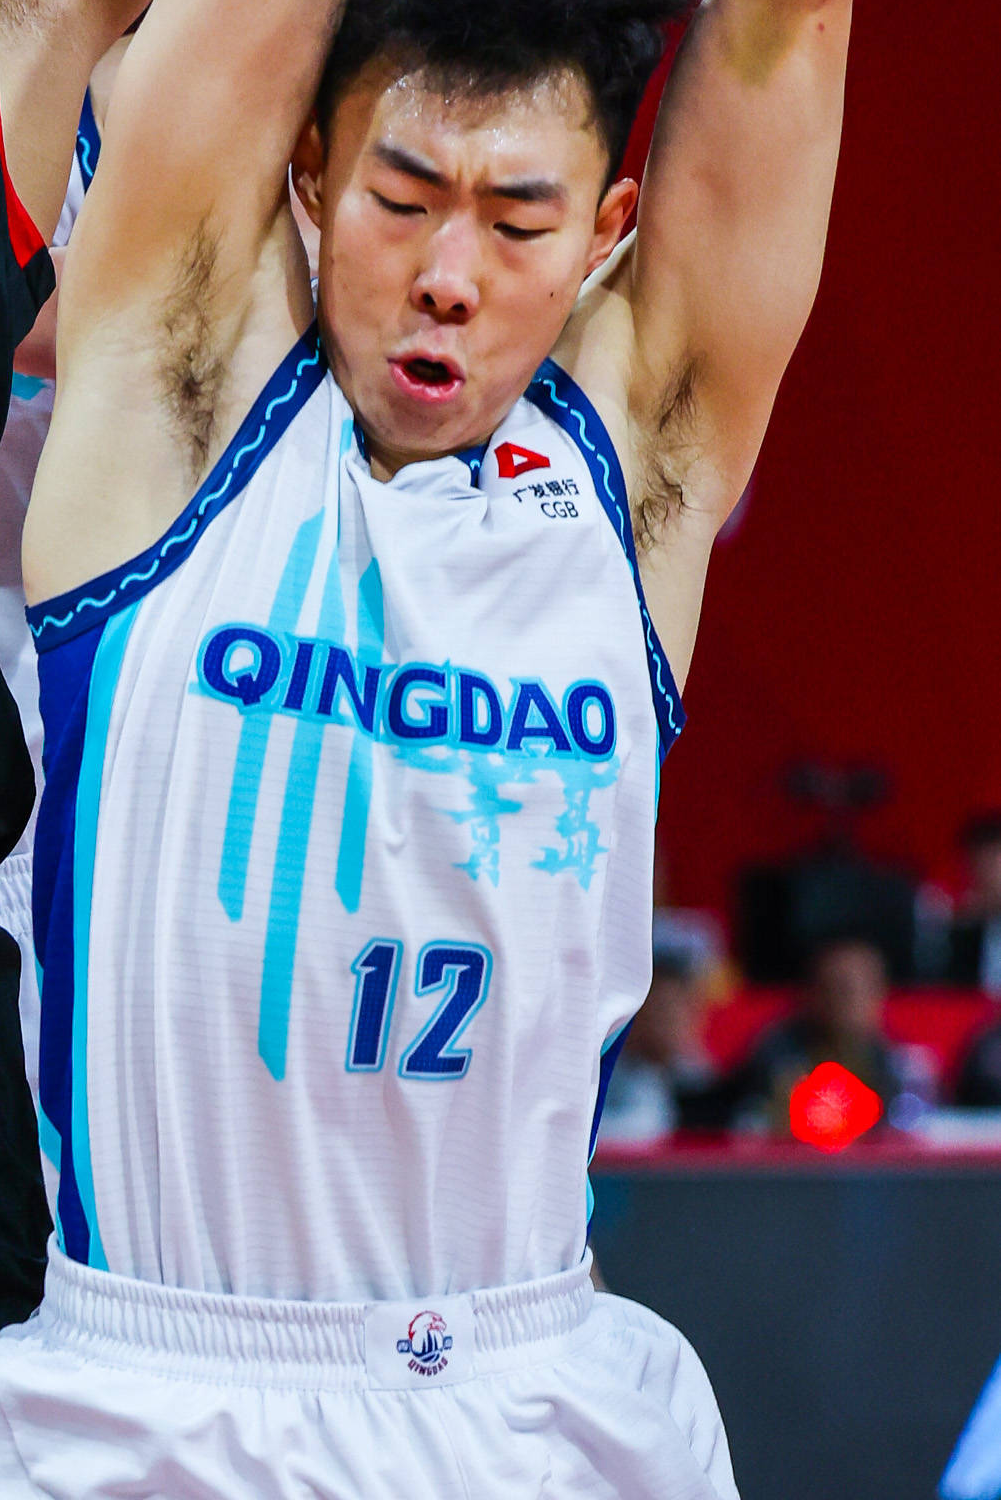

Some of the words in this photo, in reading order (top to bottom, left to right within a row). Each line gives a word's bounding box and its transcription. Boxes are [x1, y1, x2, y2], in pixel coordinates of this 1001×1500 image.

[540, 501, 579, 518] CGB
[200, 624, 616, 760] QINGDAO
[345, 938, 492, 1080] 12
